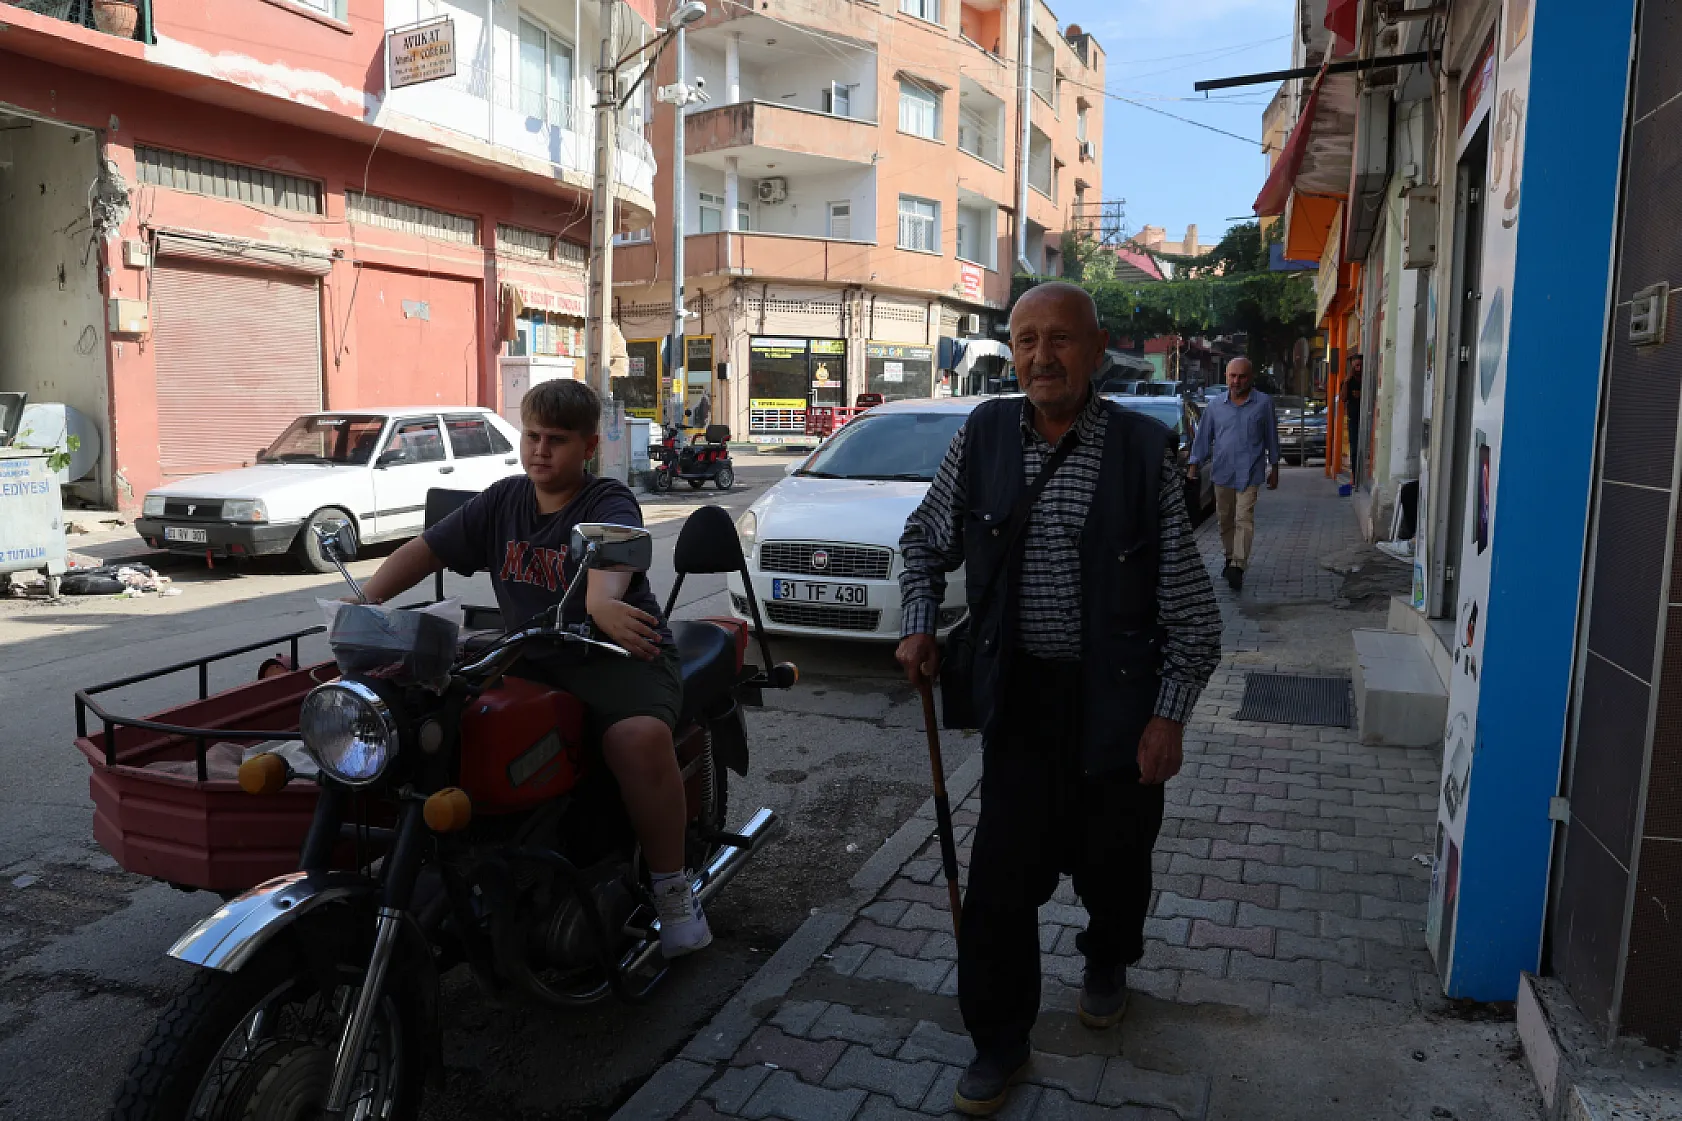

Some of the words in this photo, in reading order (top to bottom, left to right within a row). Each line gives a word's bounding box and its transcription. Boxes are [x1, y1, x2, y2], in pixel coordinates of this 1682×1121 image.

[404, 29, 440, 49] AVUKAT
[781, 581, 796, 598] 31
[806, 584, 828, 600] TF
[834, 586, 864, 604] 430
